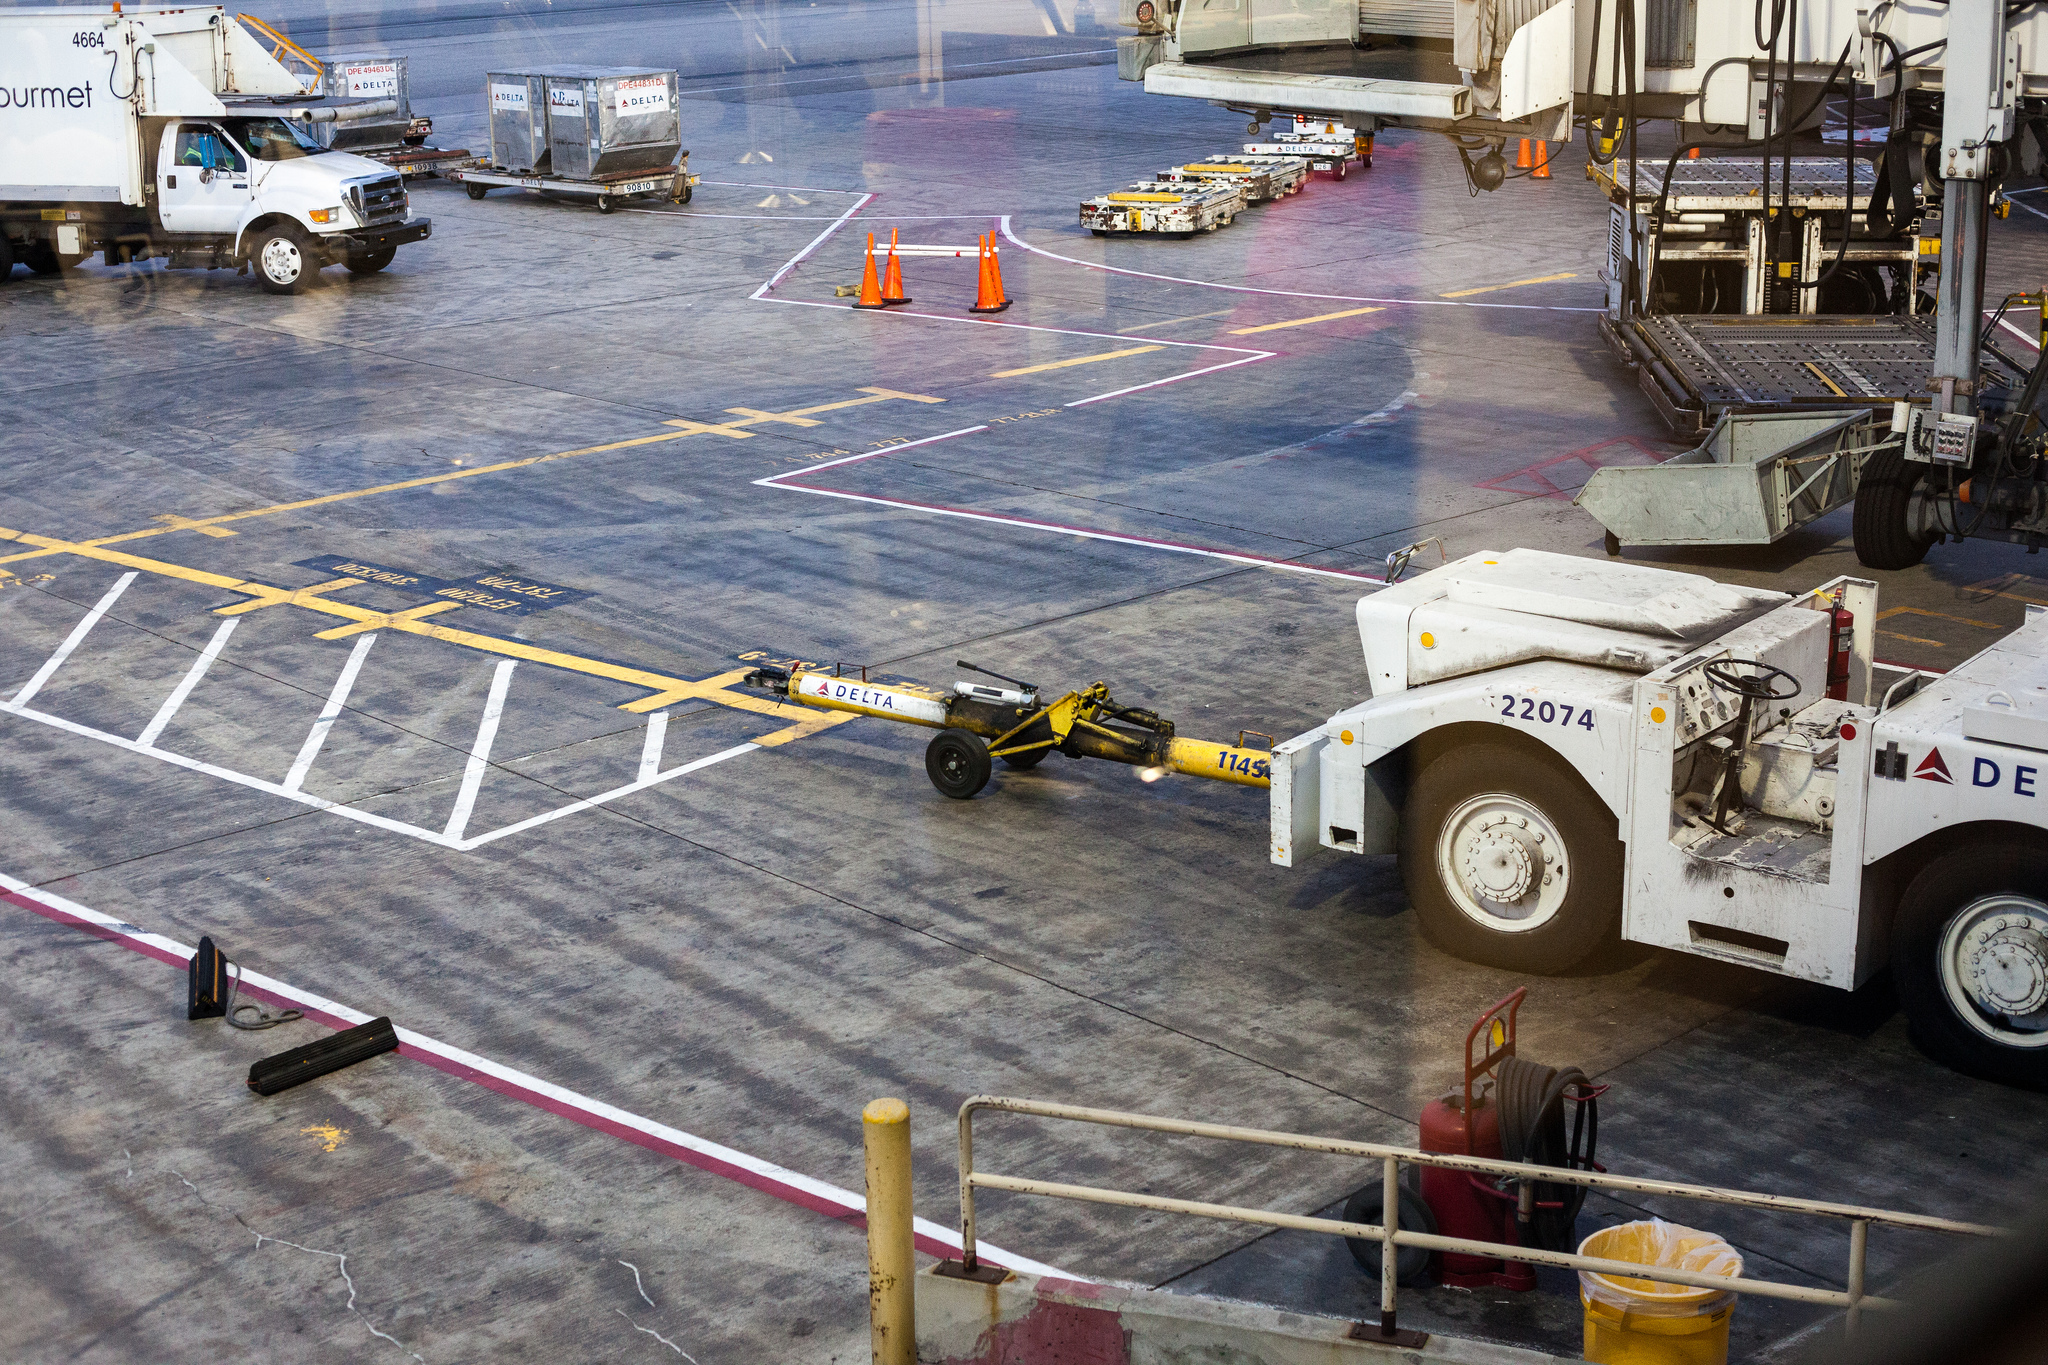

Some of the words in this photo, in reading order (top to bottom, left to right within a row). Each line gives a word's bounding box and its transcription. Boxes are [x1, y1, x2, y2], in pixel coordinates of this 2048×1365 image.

[72, 31, 105, 48] 4664
[347, 67, 362, 76] DPE
[363, 80, 393, 89] DELTA
[501, 93, 524, 102] DELTA
[631, 95, 664, 106] DELTA
[1285, 145, 1314, 153] DELTA
[626, 182, 651, 192] 90810
[835, 684, 894, 709] DELTA
[1501, 694, 1595, 732] 22074
[1218, 751, 1271, 781] 1145
[1972, 756, 2038, 798] DE
